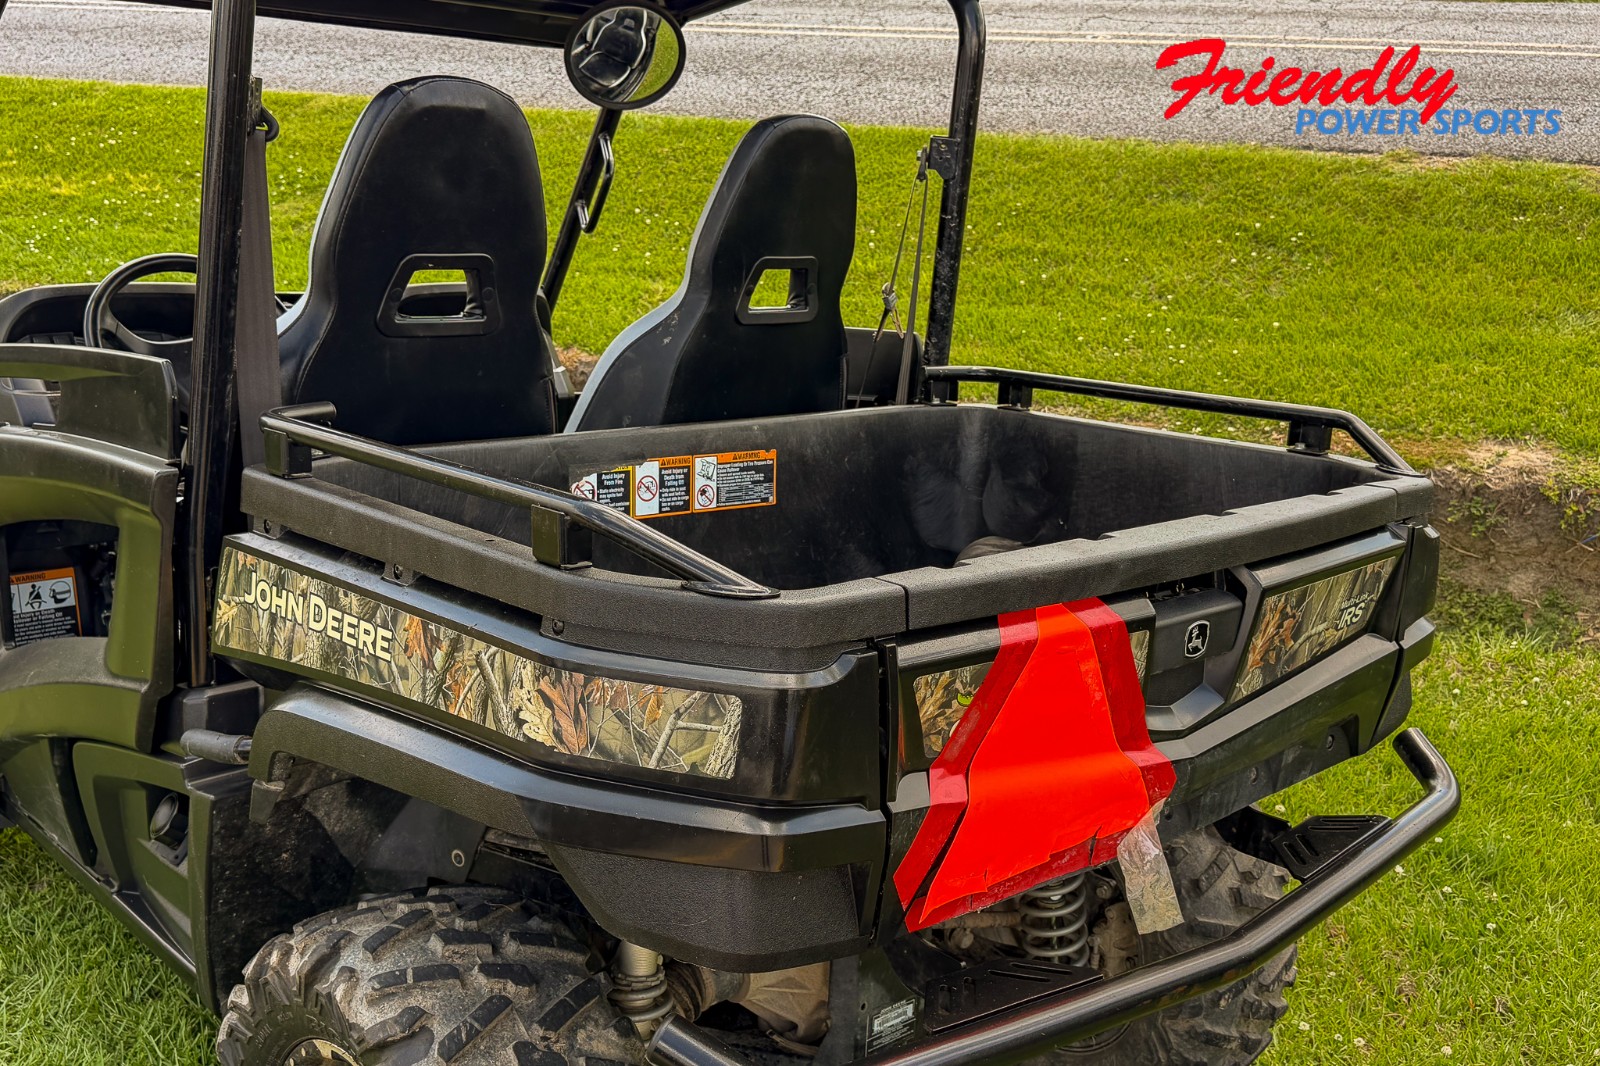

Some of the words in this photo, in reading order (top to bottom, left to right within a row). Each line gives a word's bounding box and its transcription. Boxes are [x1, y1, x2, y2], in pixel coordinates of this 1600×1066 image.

[666, 458, 690, 466] WARNING
[15, 572, 46, 582] WARNING
[244, 572, 303, 624] JOHN
[308, 594, 393, 662] DEERE
